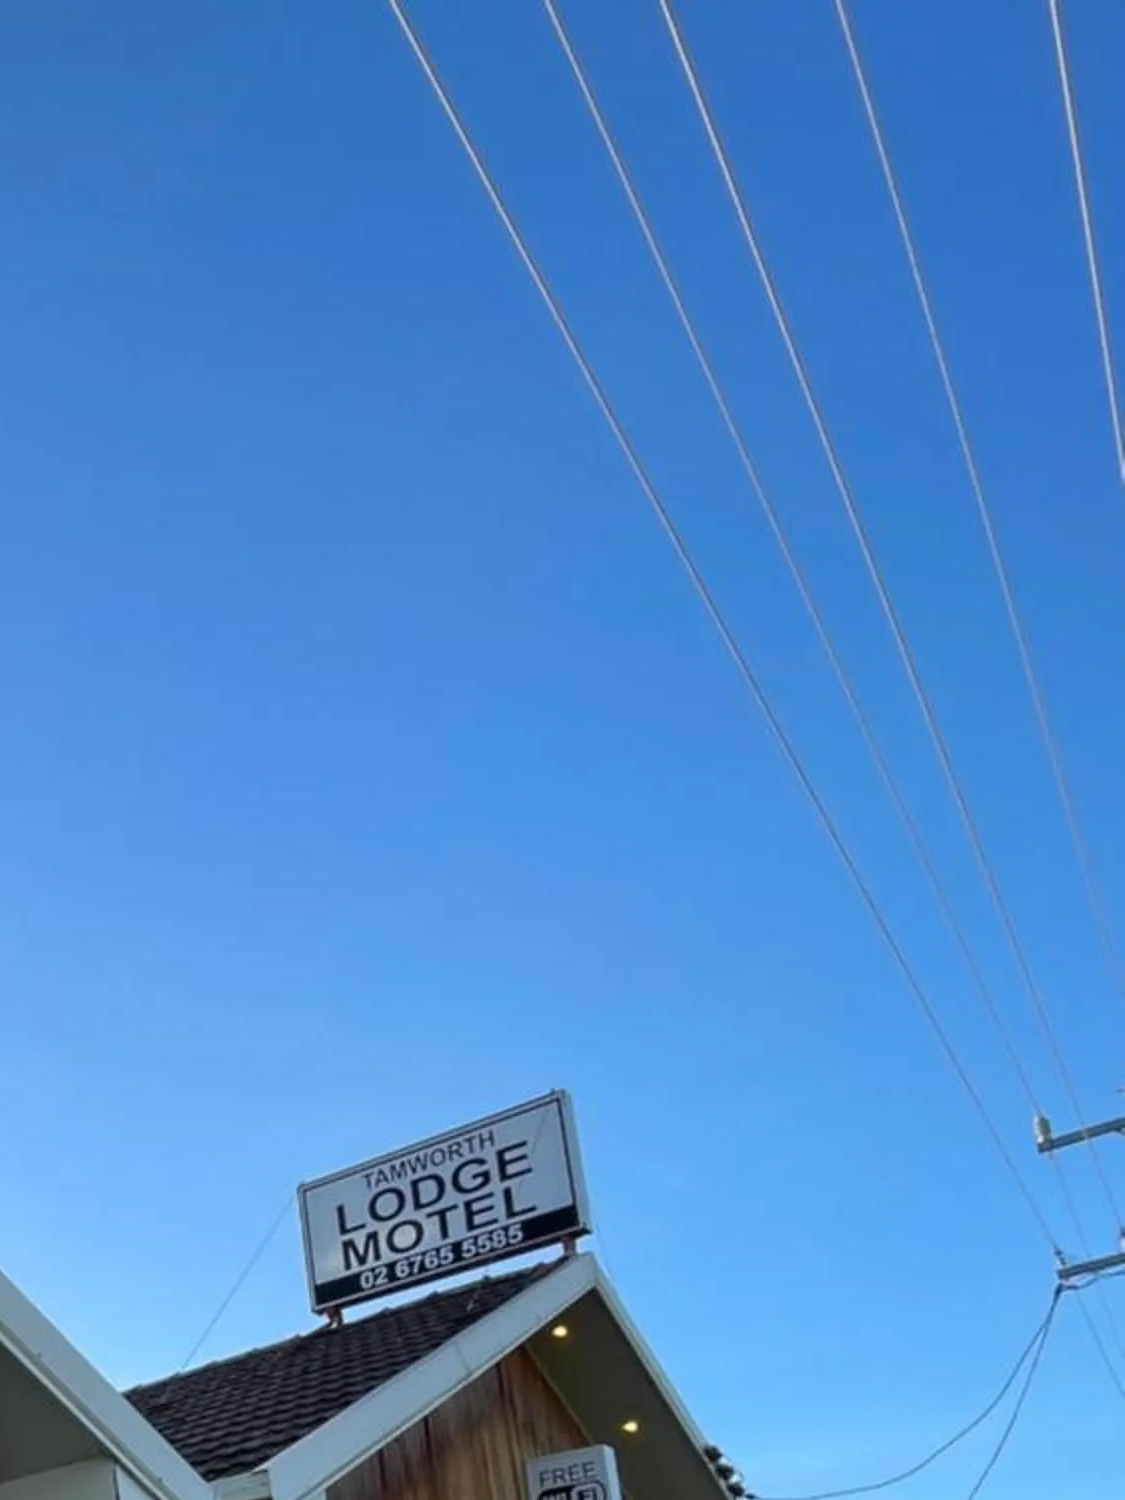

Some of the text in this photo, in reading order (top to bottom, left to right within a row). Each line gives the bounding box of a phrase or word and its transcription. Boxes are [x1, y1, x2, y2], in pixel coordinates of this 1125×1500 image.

[336, 1140, 533, 1236] LODGE
[362, 1129, 496, 1190] TAMWORTH
[341, 1186, 537, 1271] MOTEL
[359, 1224, 525, 1290] 02 6765 5585
[539, 1461, 599, 1488] FREE
